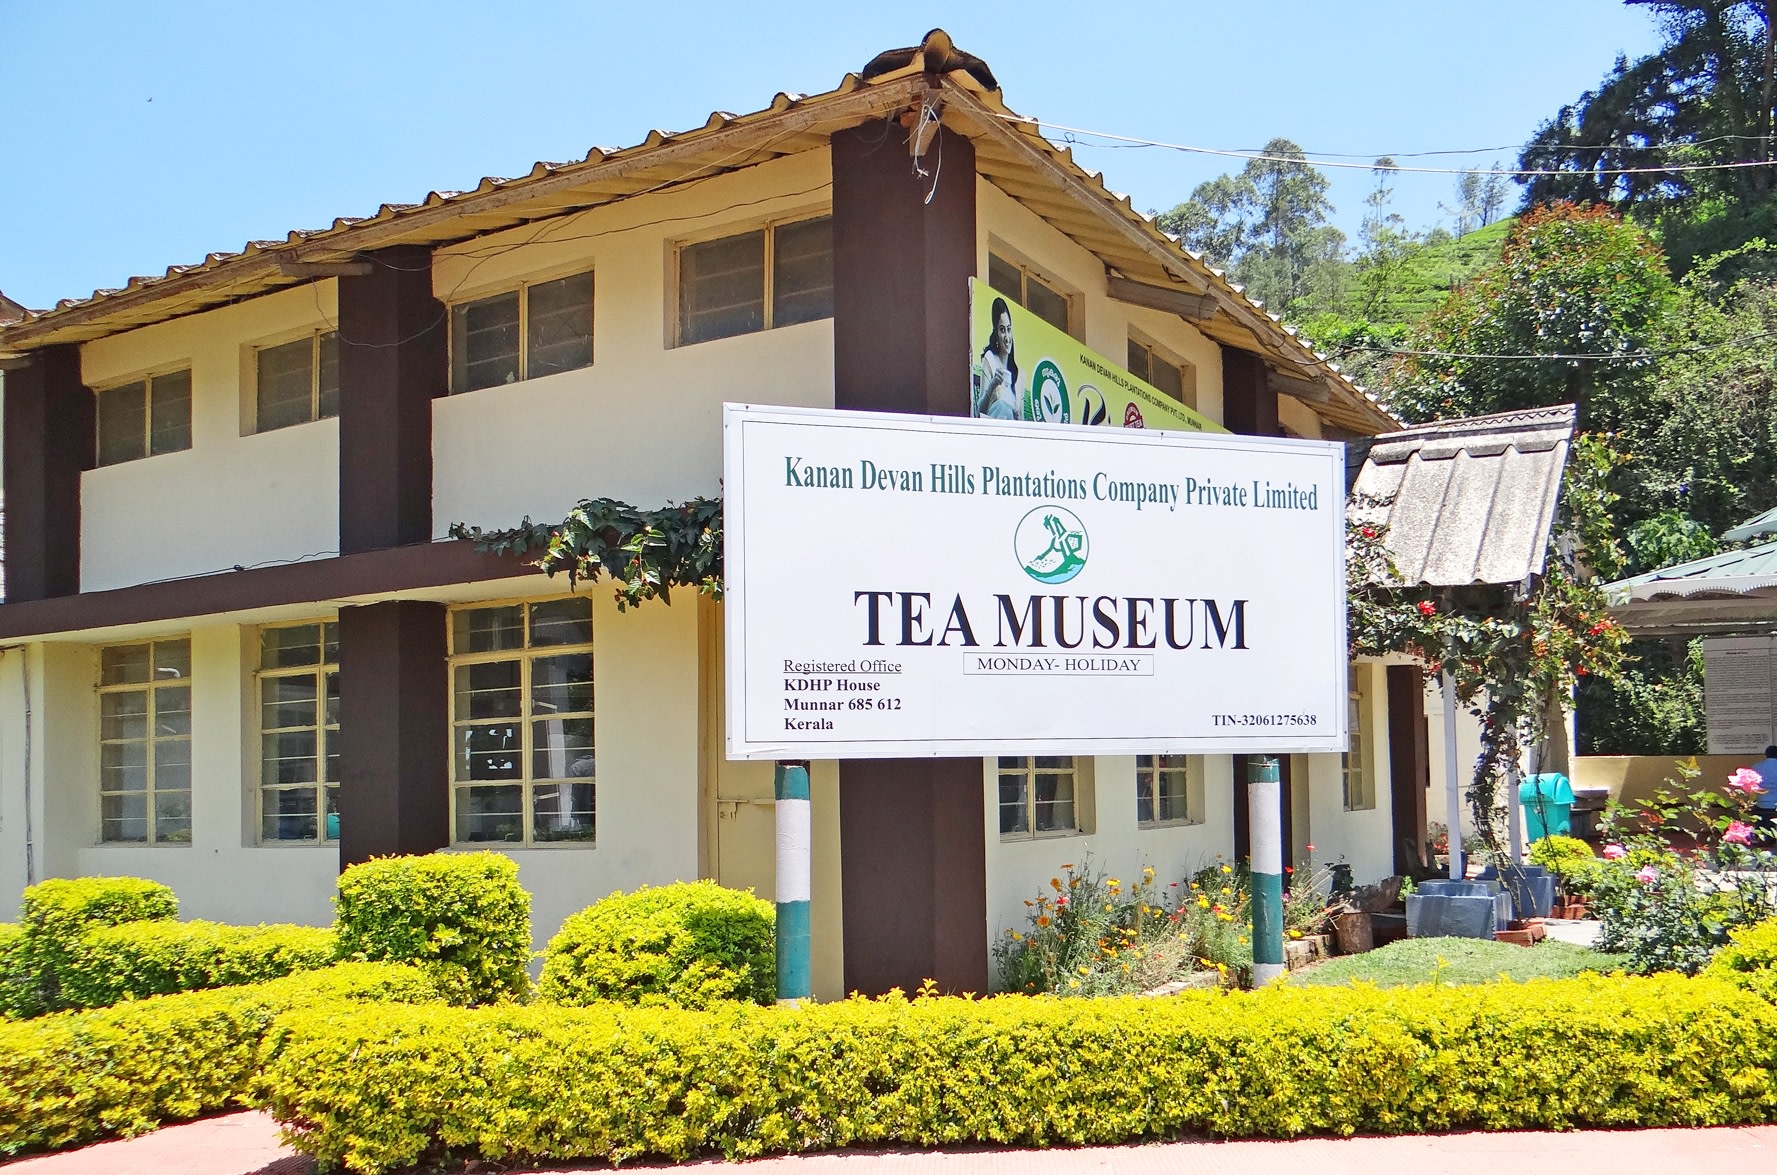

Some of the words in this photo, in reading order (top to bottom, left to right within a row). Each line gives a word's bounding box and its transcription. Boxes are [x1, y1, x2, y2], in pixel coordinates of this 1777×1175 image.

[1080, 354, 1096, 371] KANAN
[1096, 364, 1112, 381] DEVAN
[1112, 373, 1125, 388] HILLS
[1124, 380, 1152, 404] PLANTATIONS
[1151, 396, 1170, 414] COMPANY
[785, 456, 854, 489] Kanan
[860, 460, 923, 492] Devan
[930, 463, 975, 495] Hills
[981, 466, 1087, 500] Plantations
[1092, 471, 1180, 512] Company
[1185, 477, 1247, 508] Private
[1252, 480, 1318, 511] Limited
[854, 590, 980, 647] TEA
[993, 593, 1250, 650] MUSEUM
[783, 659, 856, 675] Registered
[860, 659, 902, 673] Office
[1064, 658, 1141, 671] HOLIDAY
[783, 678, 833, 692] KDHP
[837, 679, 881, 692] House
[783, 698, 845, 711] Munnar
[848, 698, 873, 711] 685
[877, 698, 902, 711] 612
[784, 717, 834, 730] Kerala
[1211, 714, 1317, 726] TIN-32061275638
